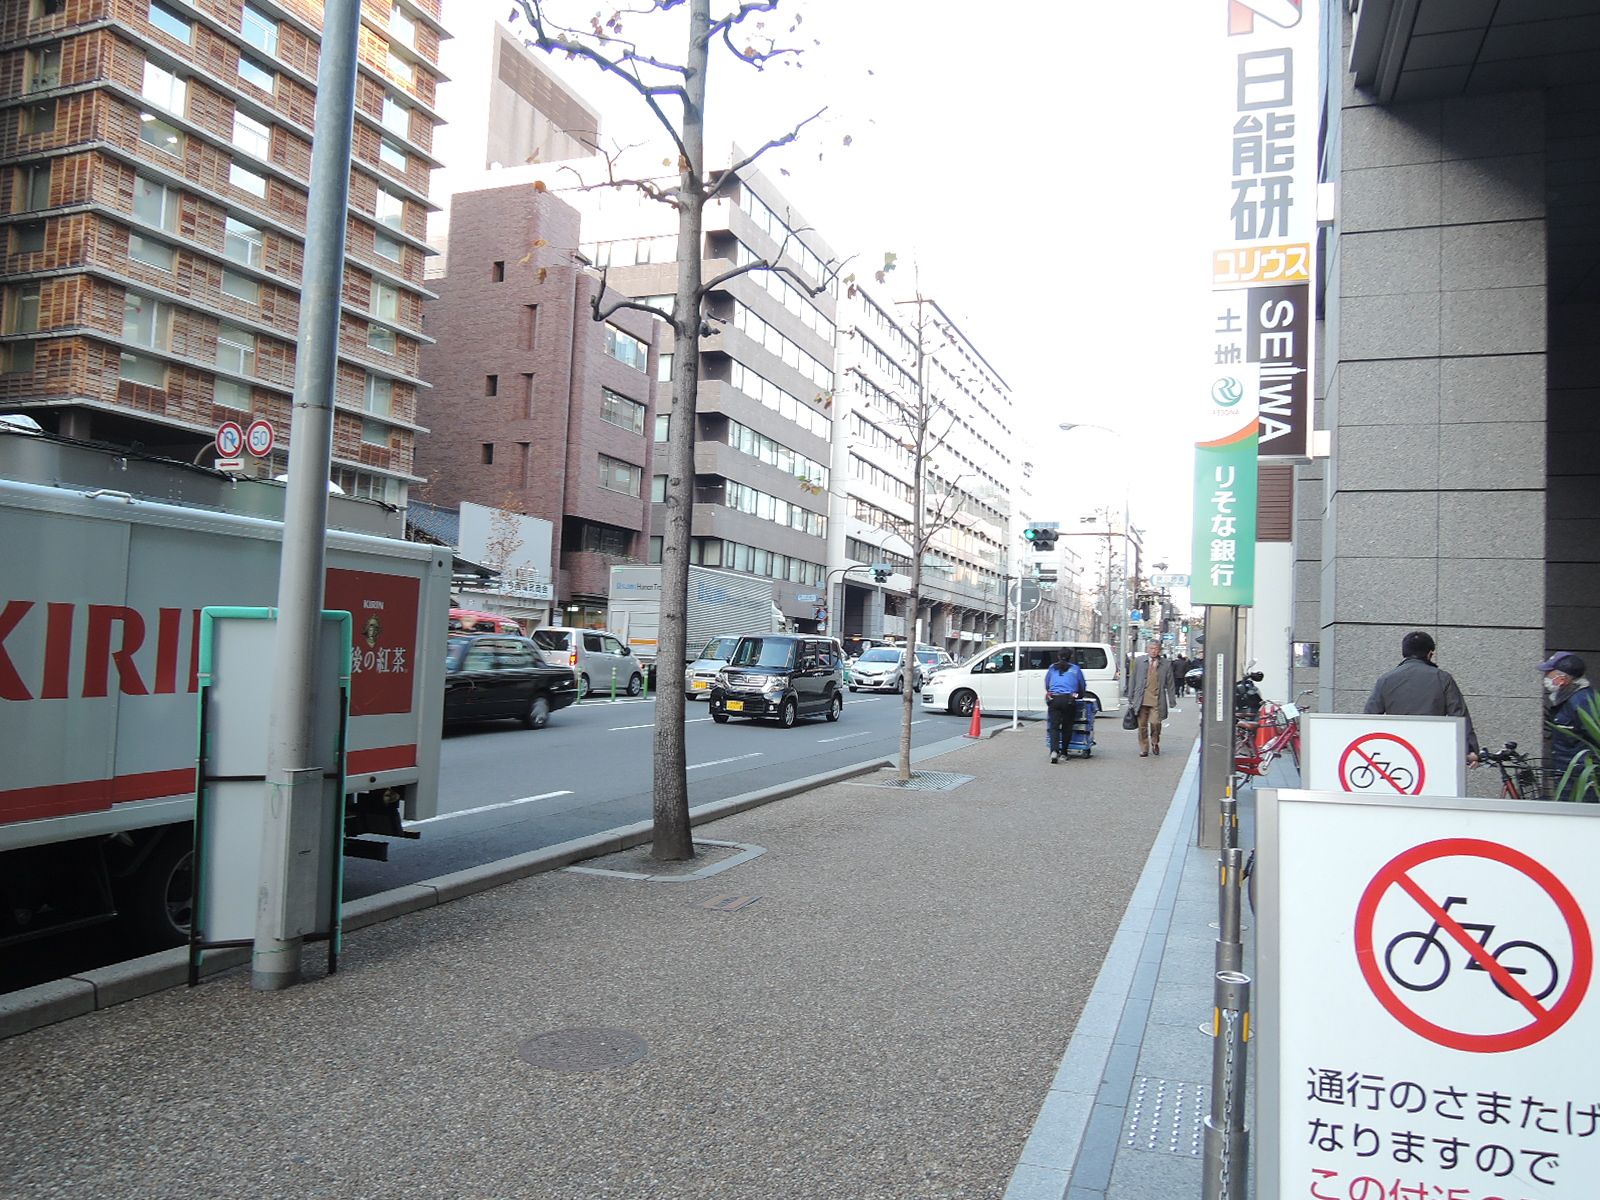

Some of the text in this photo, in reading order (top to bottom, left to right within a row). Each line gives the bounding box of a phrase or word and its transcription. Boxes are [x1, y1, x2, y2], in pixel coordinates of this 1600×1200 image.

[1230, 47, 1295, 240] 日能研
[1214, 246, 1308, 279] ユリウス
[1214, 307, 1242, 365] 土地
[252, 431, 268, 446] 50
[1210, 465, 1236, 587] りそな銀行
[363, 600, 384, 610] KIRIN
[0, 600, 201, 701] KIRI
[1308, 1117, 1560, 1186] なりますので
